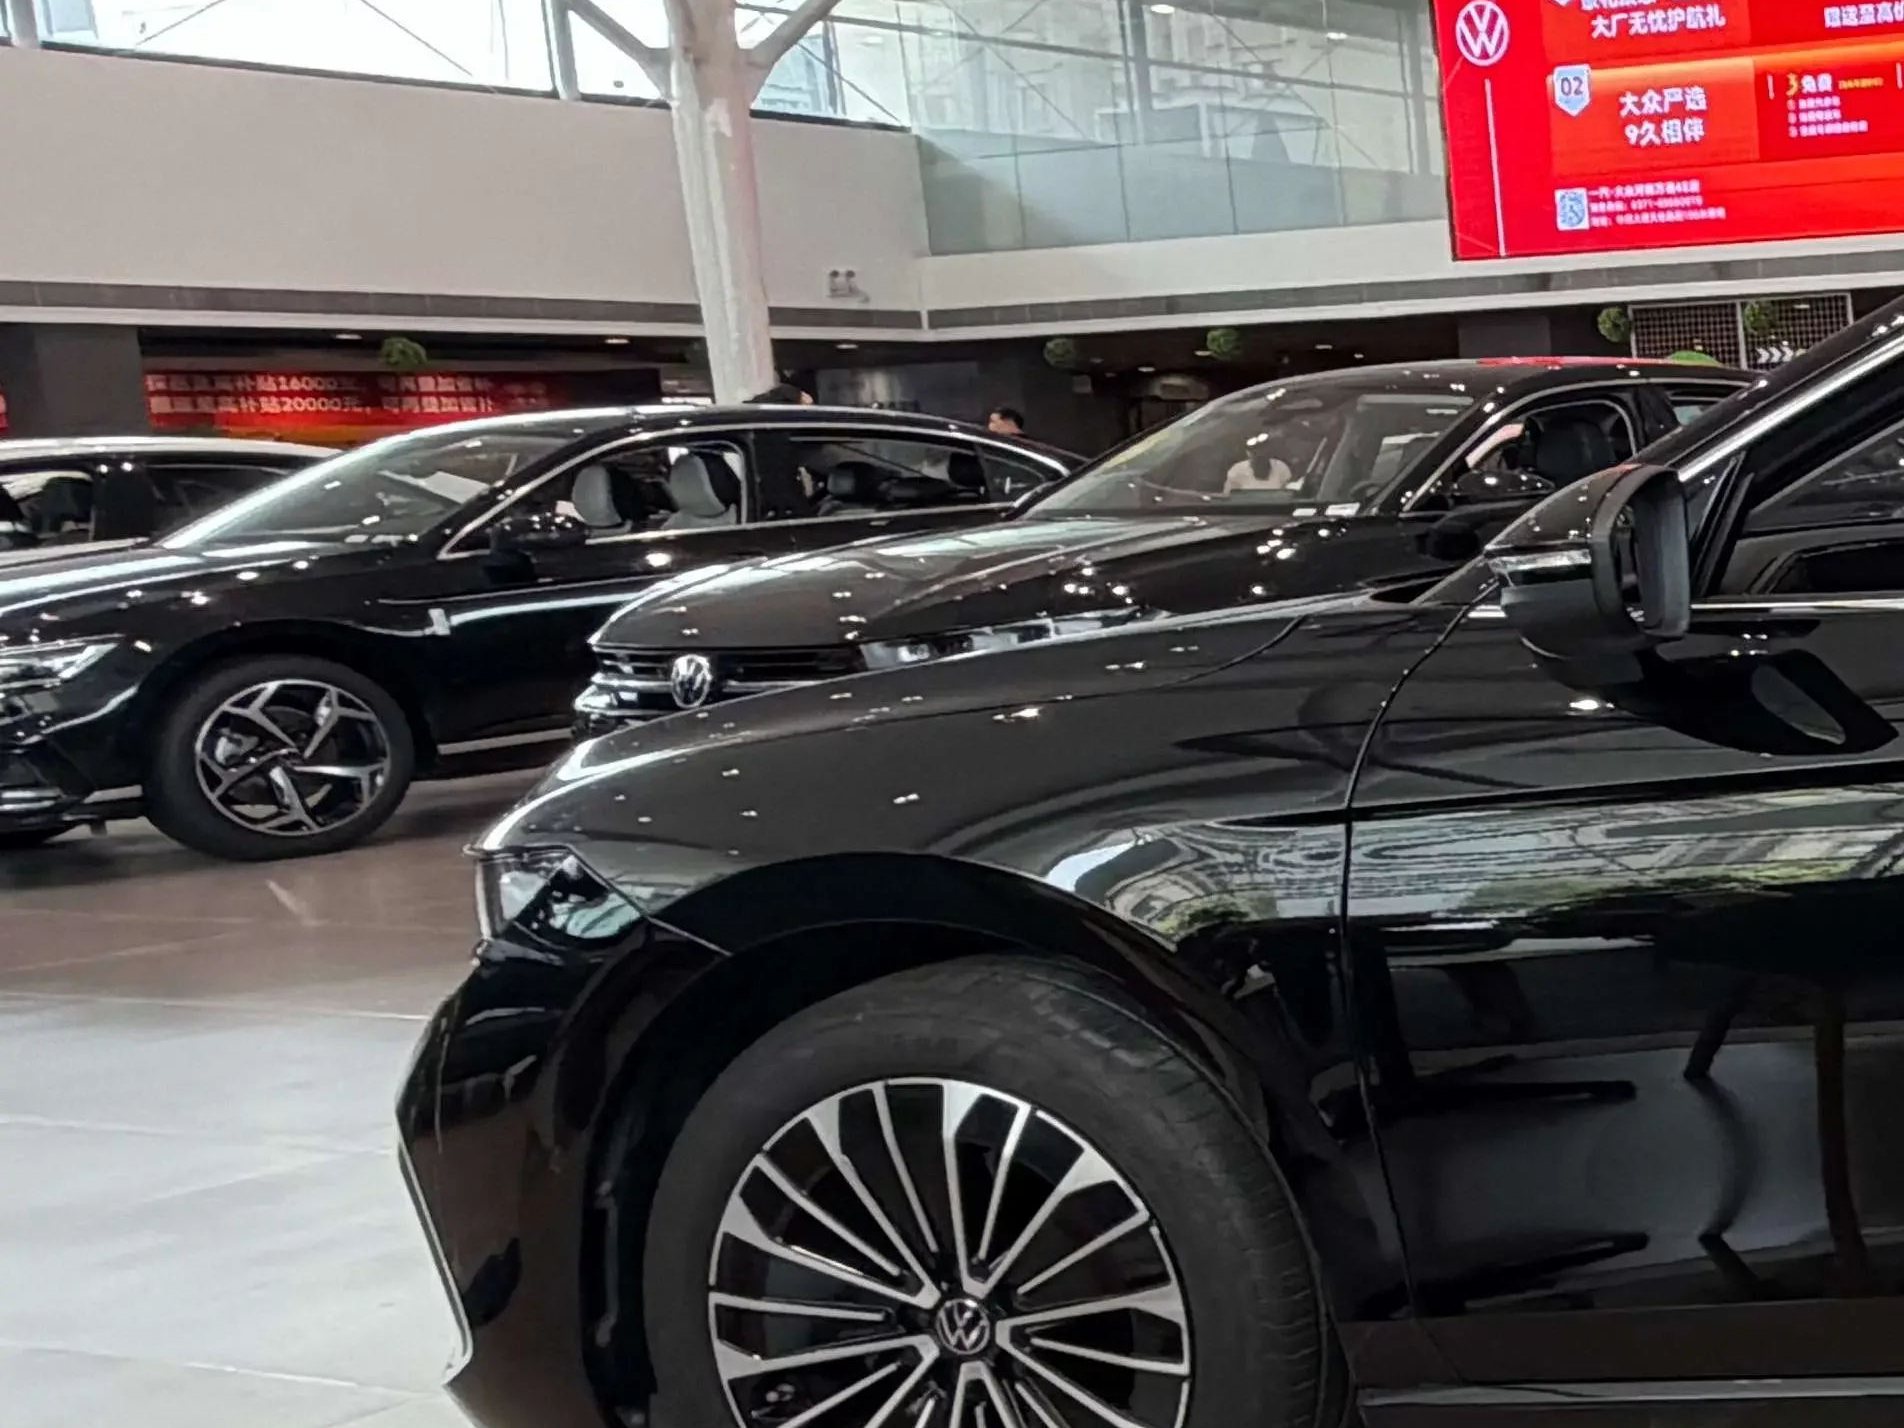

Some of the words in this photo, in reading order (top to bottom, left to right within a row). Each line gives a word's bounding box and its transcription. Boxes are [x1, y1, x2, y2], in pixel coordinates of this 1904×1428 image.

[1561, 77, 1583, 96] 02
[1619, 86, 1708, 117] 大众严选
[1624, 117, 1705, 147] 9久相伴
